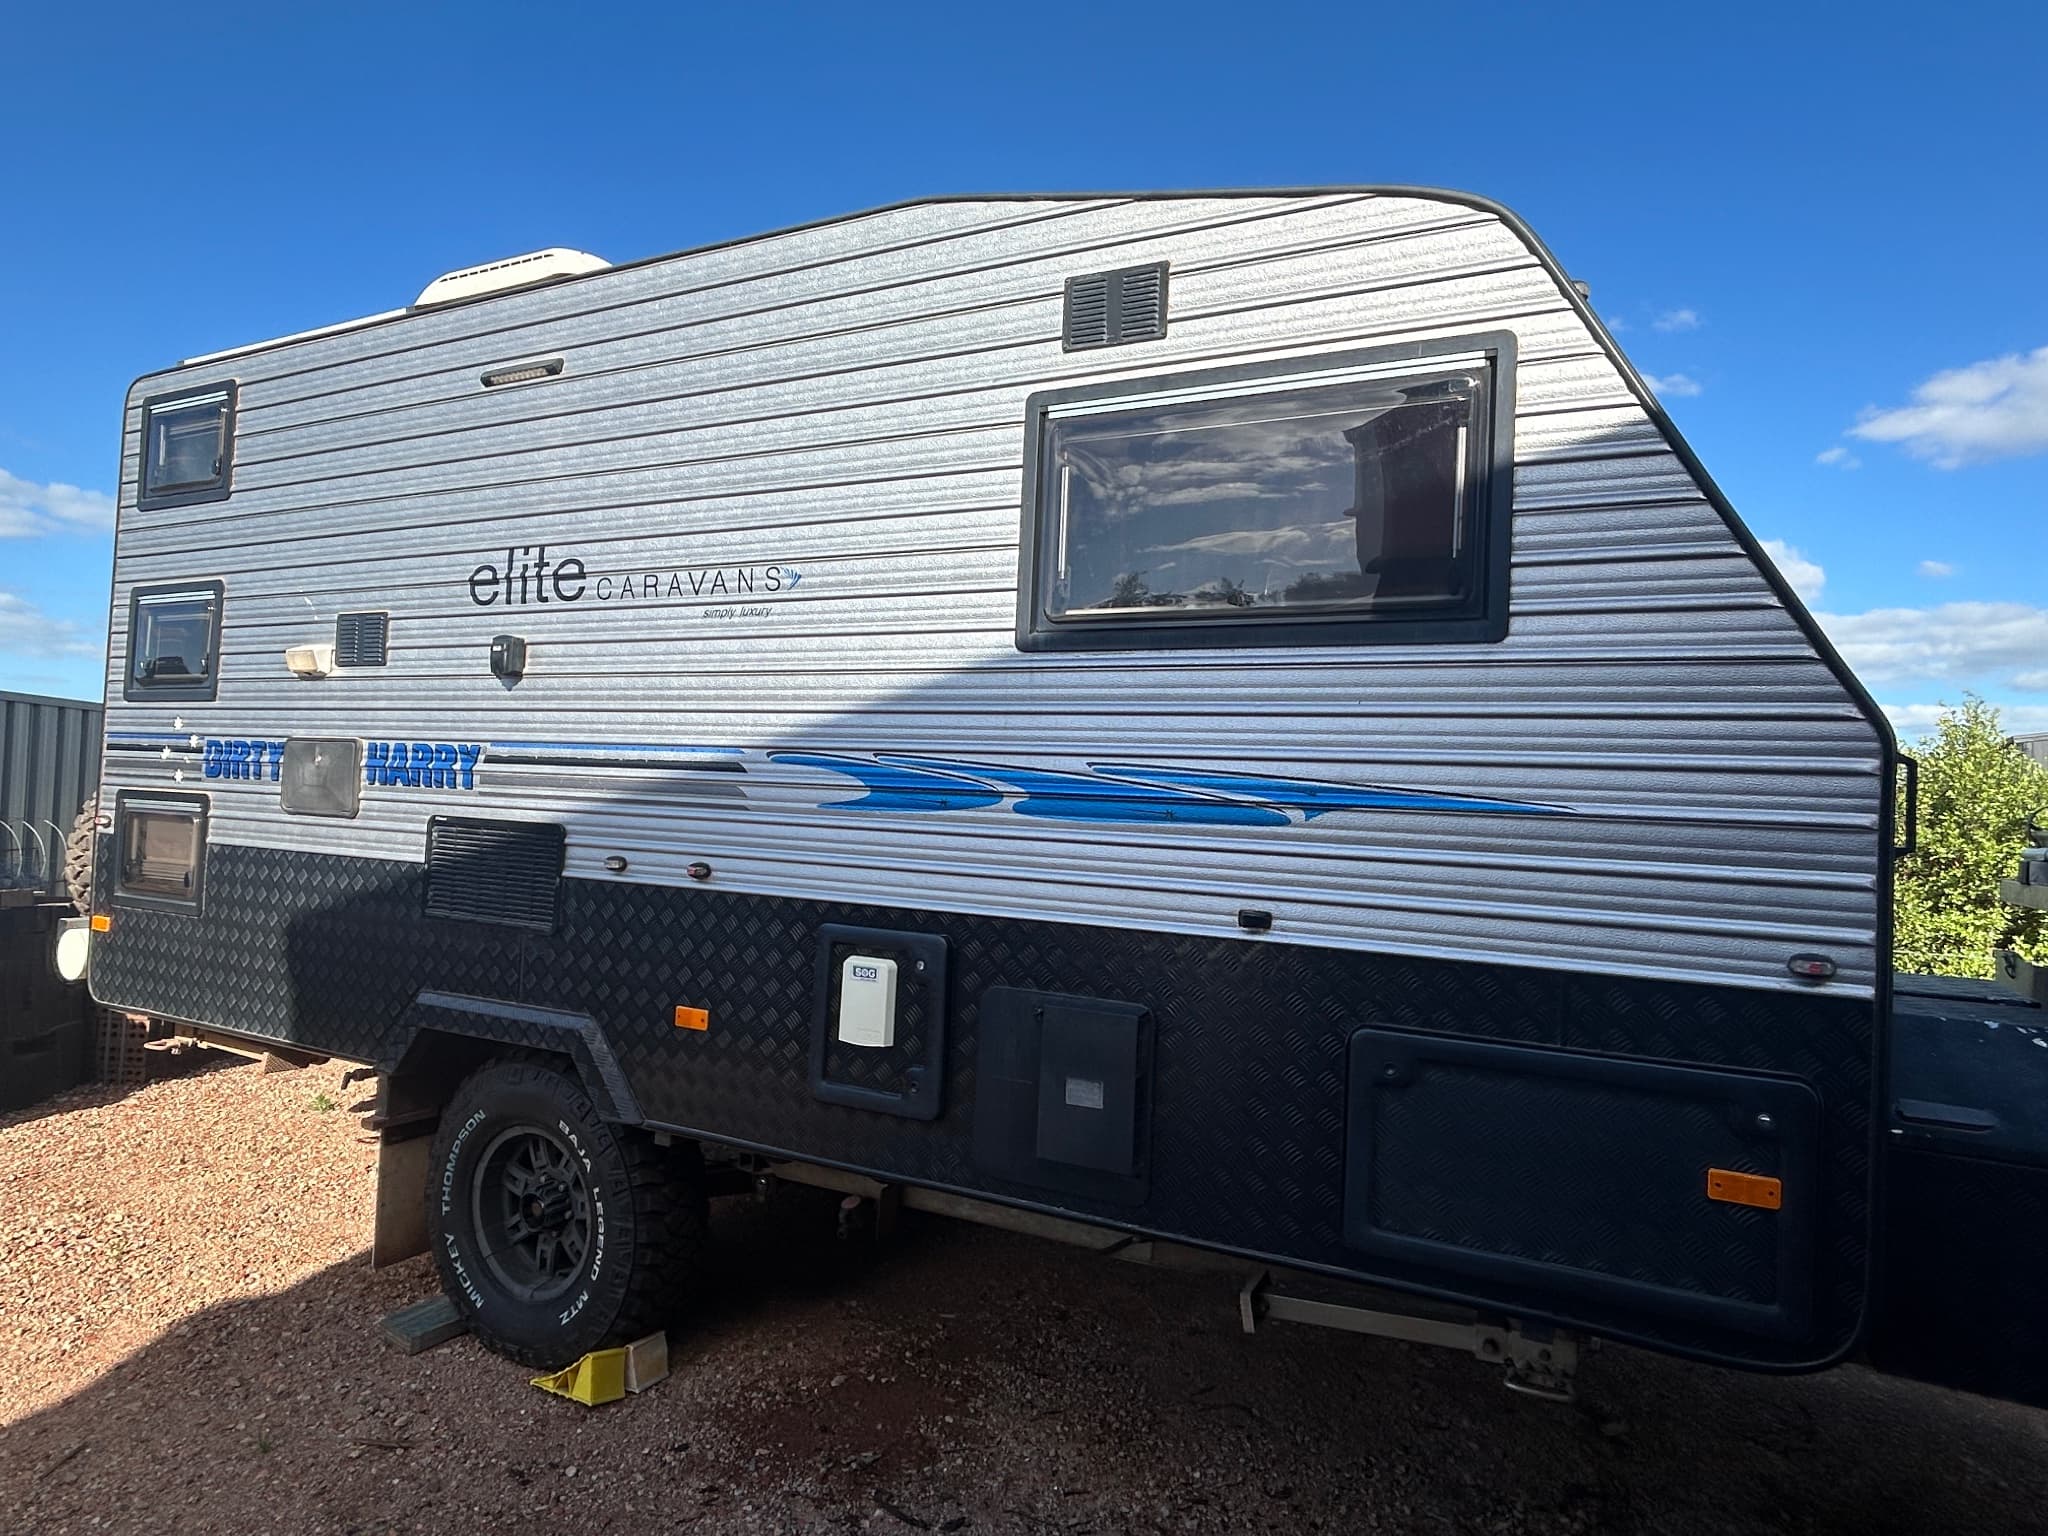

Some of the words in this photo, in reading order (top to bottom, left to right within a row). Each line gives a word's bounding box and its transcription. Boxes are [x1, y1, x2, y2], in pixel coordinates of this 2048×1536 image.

[468, 546, 587, 606] elite
[596, 566, 781, 601] CARAVANS
[703, 607, 737, 620] simply
[740, 606, 772, 618] luxury
[204, 739, 286, 782] DIRTY
[365, 742, 481, 790] HARRY
[855, 967, 876, 978] SOG
[441, 1109, 487, 1217] THOMPSON
[558, 1119, 592, 1174] BAJA
[591, 1186, 606, 1282] LEGEND
[444, 1232, 484, 1309] MICKEY
[558, 1289, 590, 1327] MTZ
